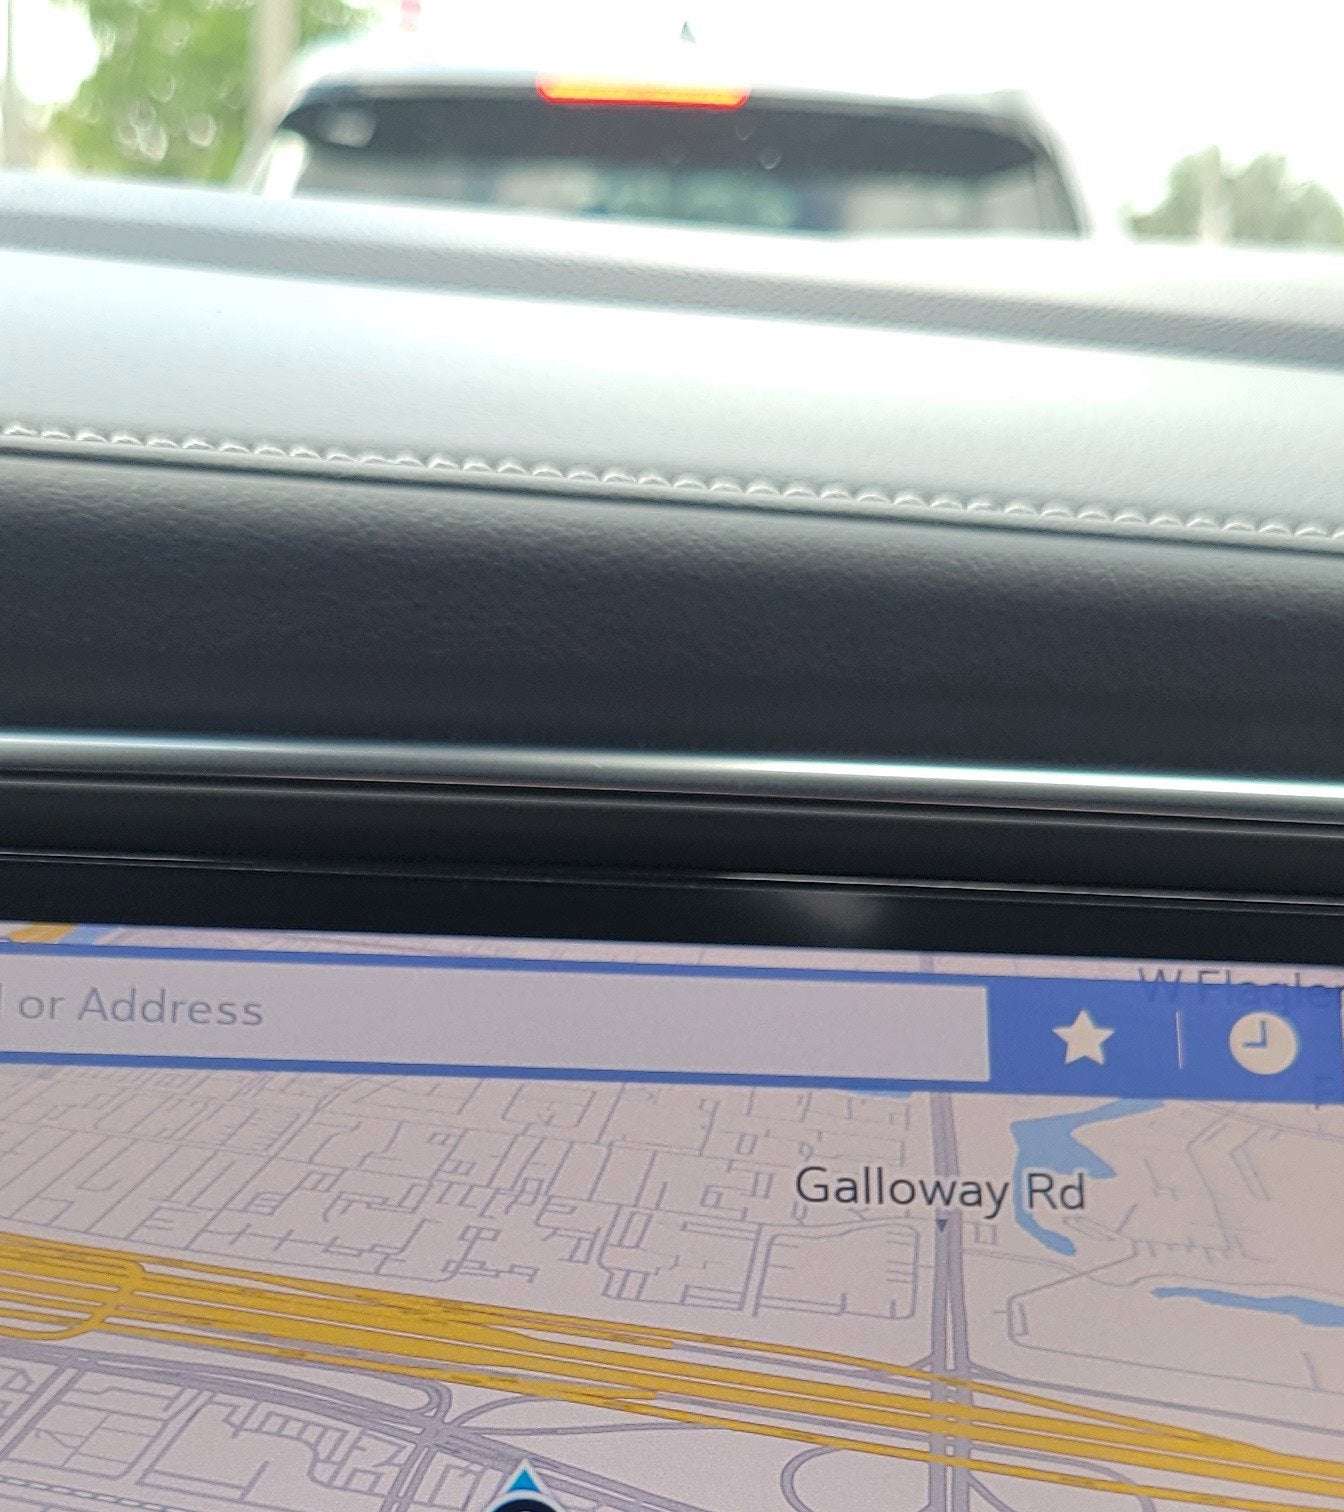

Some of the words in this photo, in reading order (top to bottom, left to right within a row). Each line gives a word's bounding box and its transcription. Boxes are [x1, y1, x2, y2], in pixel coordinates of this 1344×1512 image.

[17, 994, 65, 1019] or
[77, 986, 264, 1027] Address
[795, 1165, 1010, 1218] Galloway
[1027, 1172, 1086, 1211] Rd
